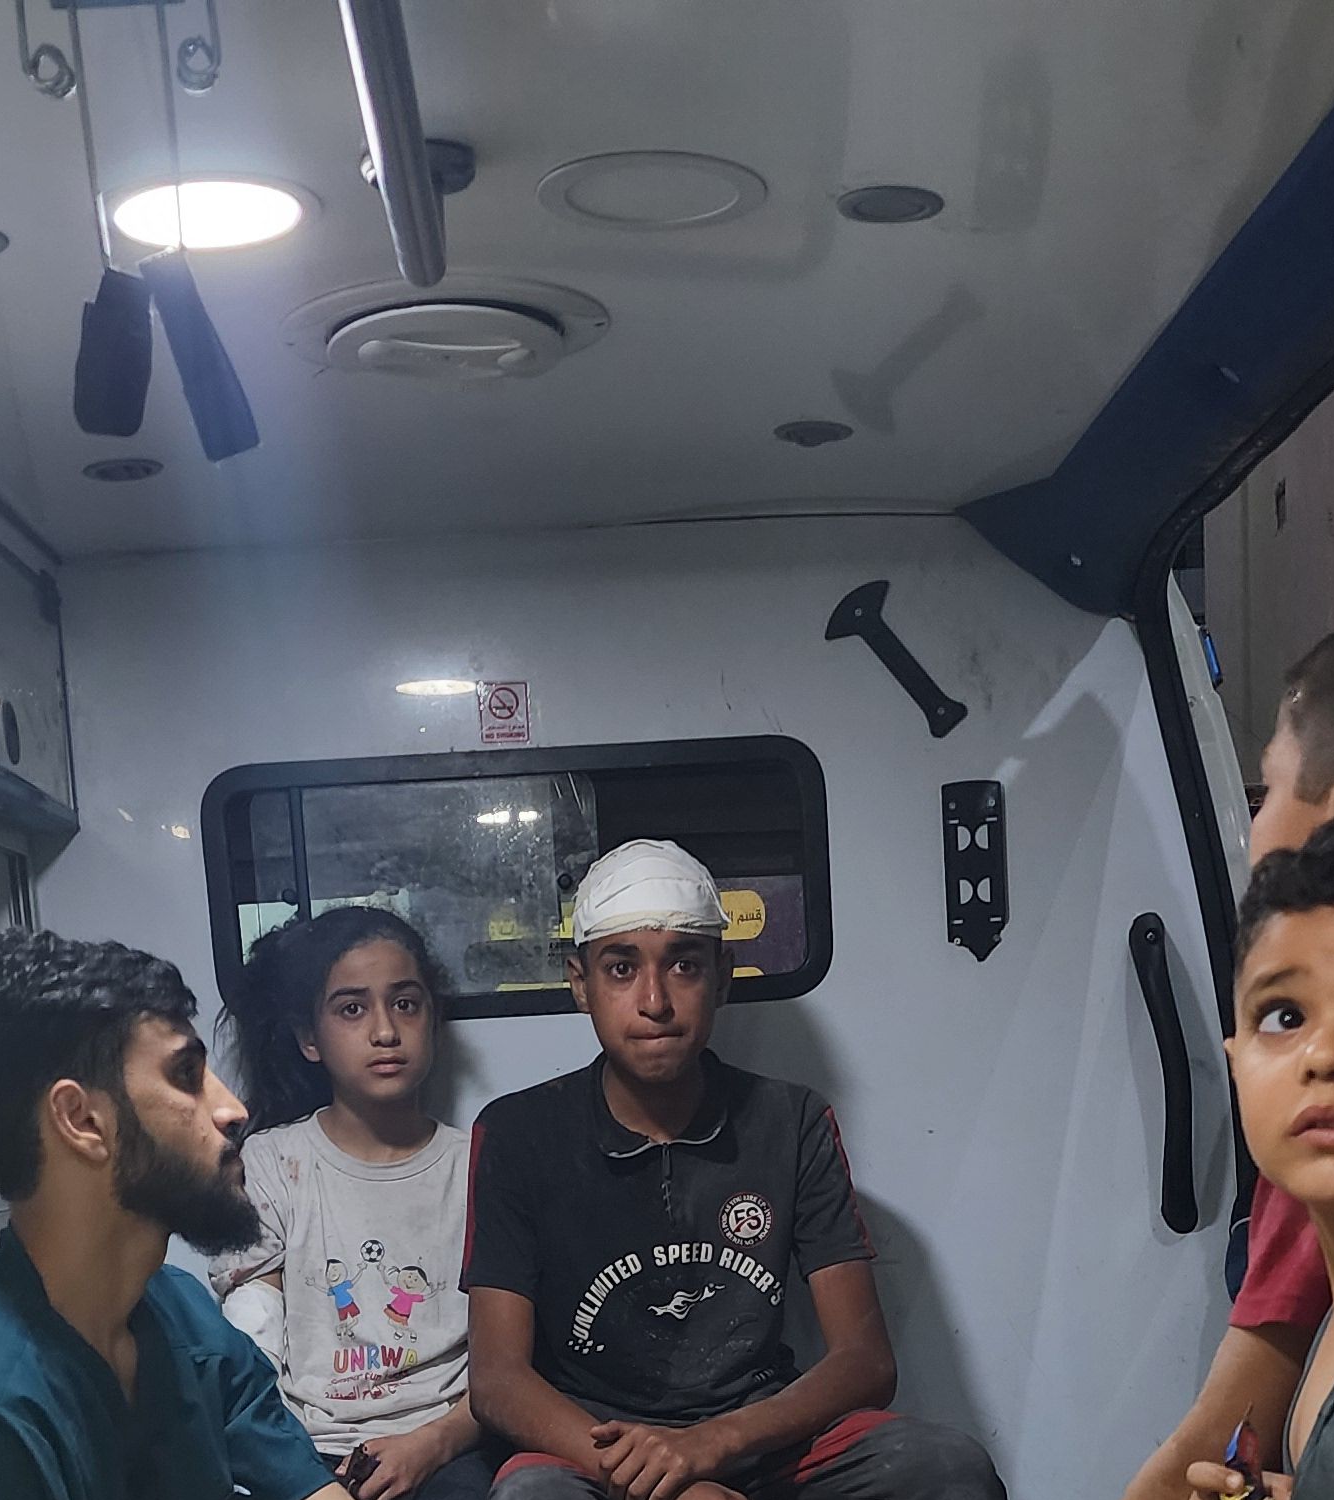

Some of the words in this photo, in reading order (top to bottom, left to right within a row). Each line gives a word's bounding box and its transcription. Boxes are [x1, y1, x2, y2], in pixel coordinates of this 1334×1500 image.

[572, 1253, 643, 1340] UNLIMITED
[653, 1243, 712, 1266] SPEED
[718, 1247, 783, 1306] RIDER'S
[334, 1344, 417, 1373] UNRWA
